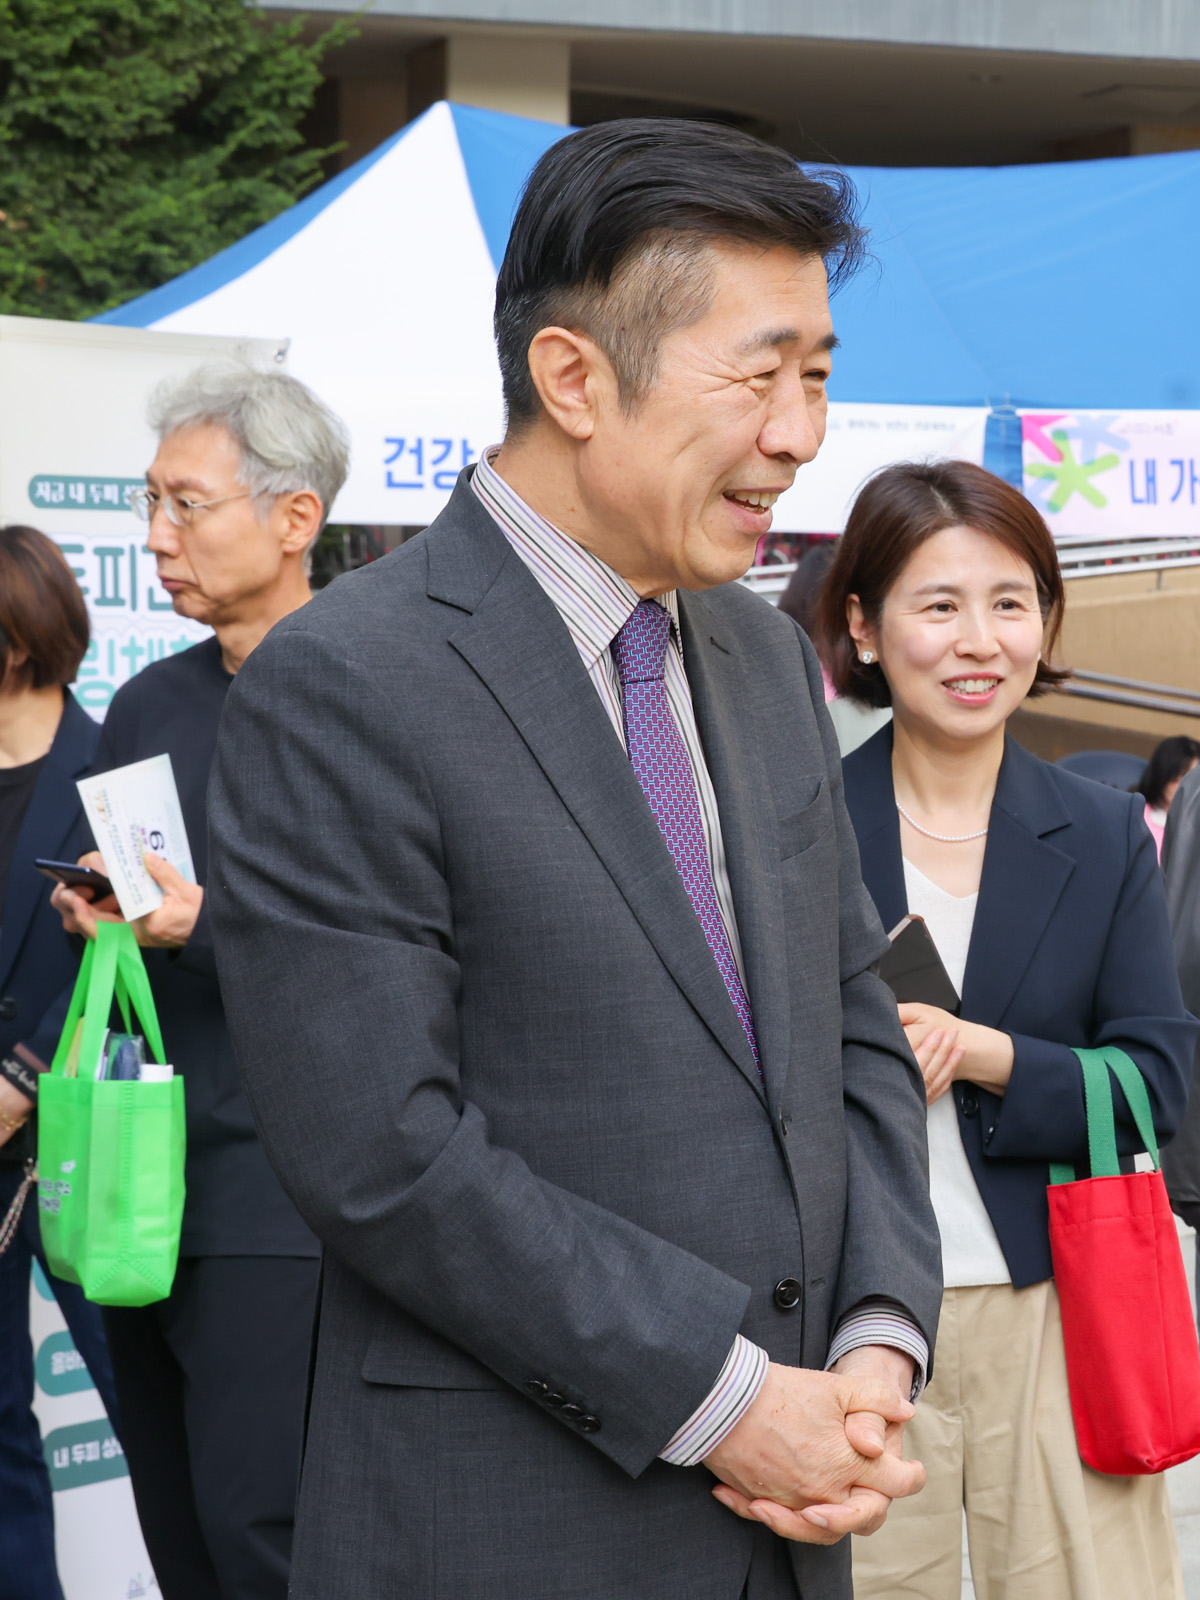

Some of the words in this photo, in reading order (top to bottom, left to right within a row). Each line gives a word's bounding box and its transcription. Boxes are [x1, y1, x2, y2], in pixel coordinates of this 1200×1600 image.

[35, 481, 65, 503] 지금
[69, 482, 86, 503] 내
[1129, 458, 1158, 504] 내
[53, 1447, 70, 1469] 내
[101, 1436, 124, 1460] 상
